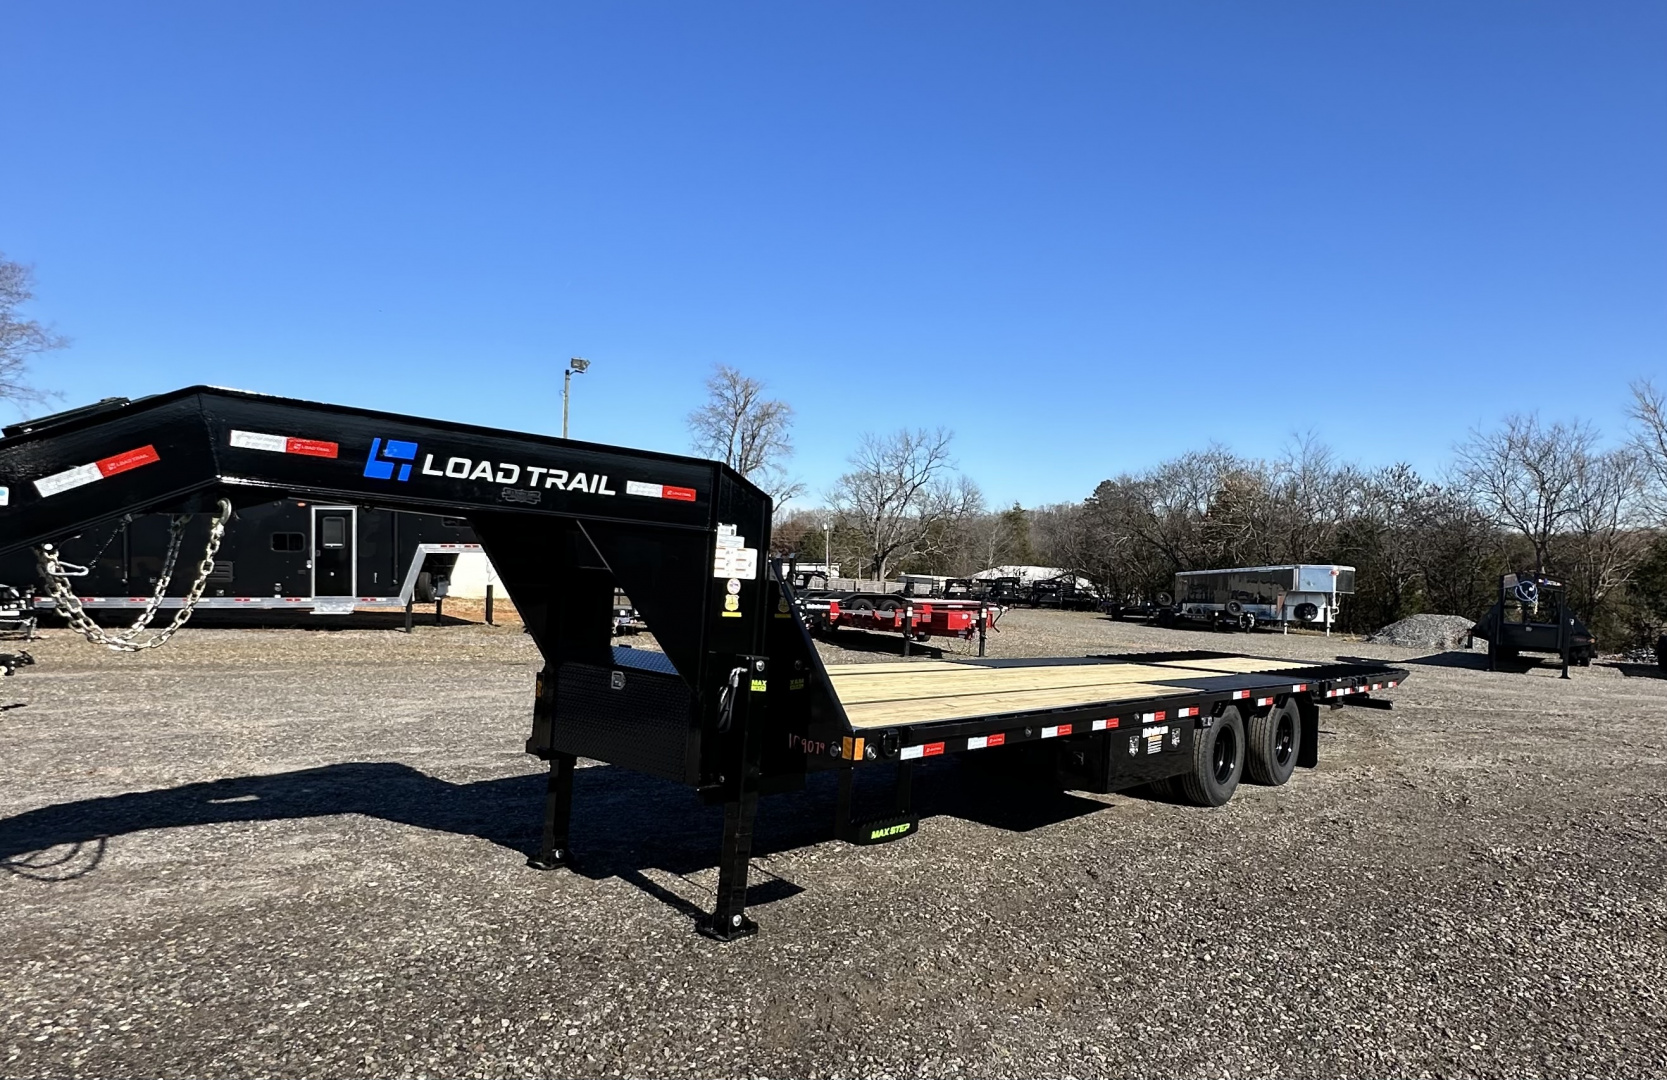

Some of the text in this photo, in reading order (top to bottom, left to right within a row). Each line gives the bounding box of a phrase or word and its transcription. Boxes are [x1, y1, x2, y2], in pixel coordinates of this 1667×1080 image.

[422, 453, 521, 485] LOAD
[526, 465, 616, 496] TRAIL
[871, 823, 911, 840] MAX STEP
